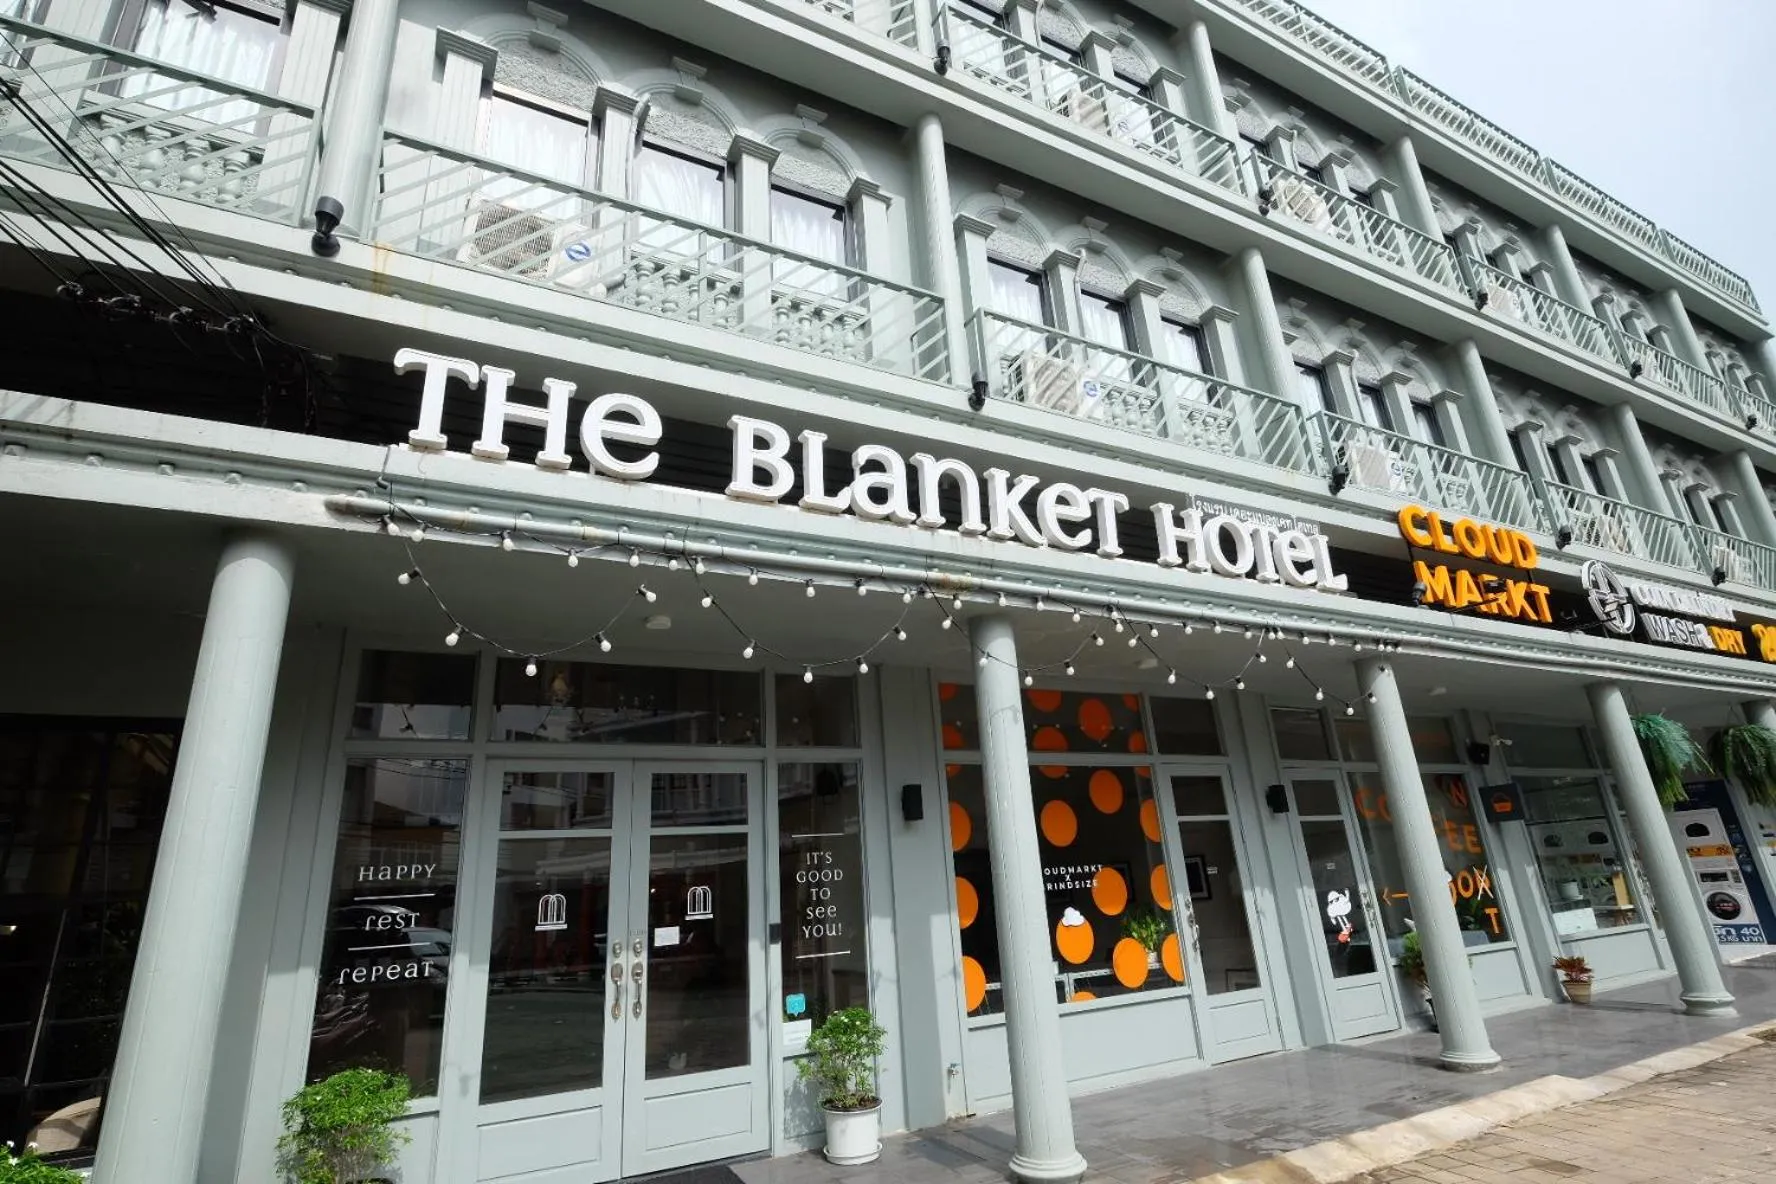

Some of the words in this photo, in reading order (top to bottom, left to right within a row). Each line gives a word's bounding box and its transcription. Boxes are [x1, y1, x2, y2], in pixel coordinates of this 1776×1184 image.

[1398, 505, 1538, 569] CLOUD
[1413, 560, 1553, 623] MARKT
[1640, 612, 1700, 648] WASH
[1707, 625, 1748, 655] DRY
[806, 851, 833, 866] IT'S
[796, 869, 844, 883] GOOD
[1043, 864, 1103, 876] OUDMARKT
[1046, 880, 1099, 892] RINDSIZE
[810, 887, 832, 901] TO
[1740, 927, 1760, 935] 40
